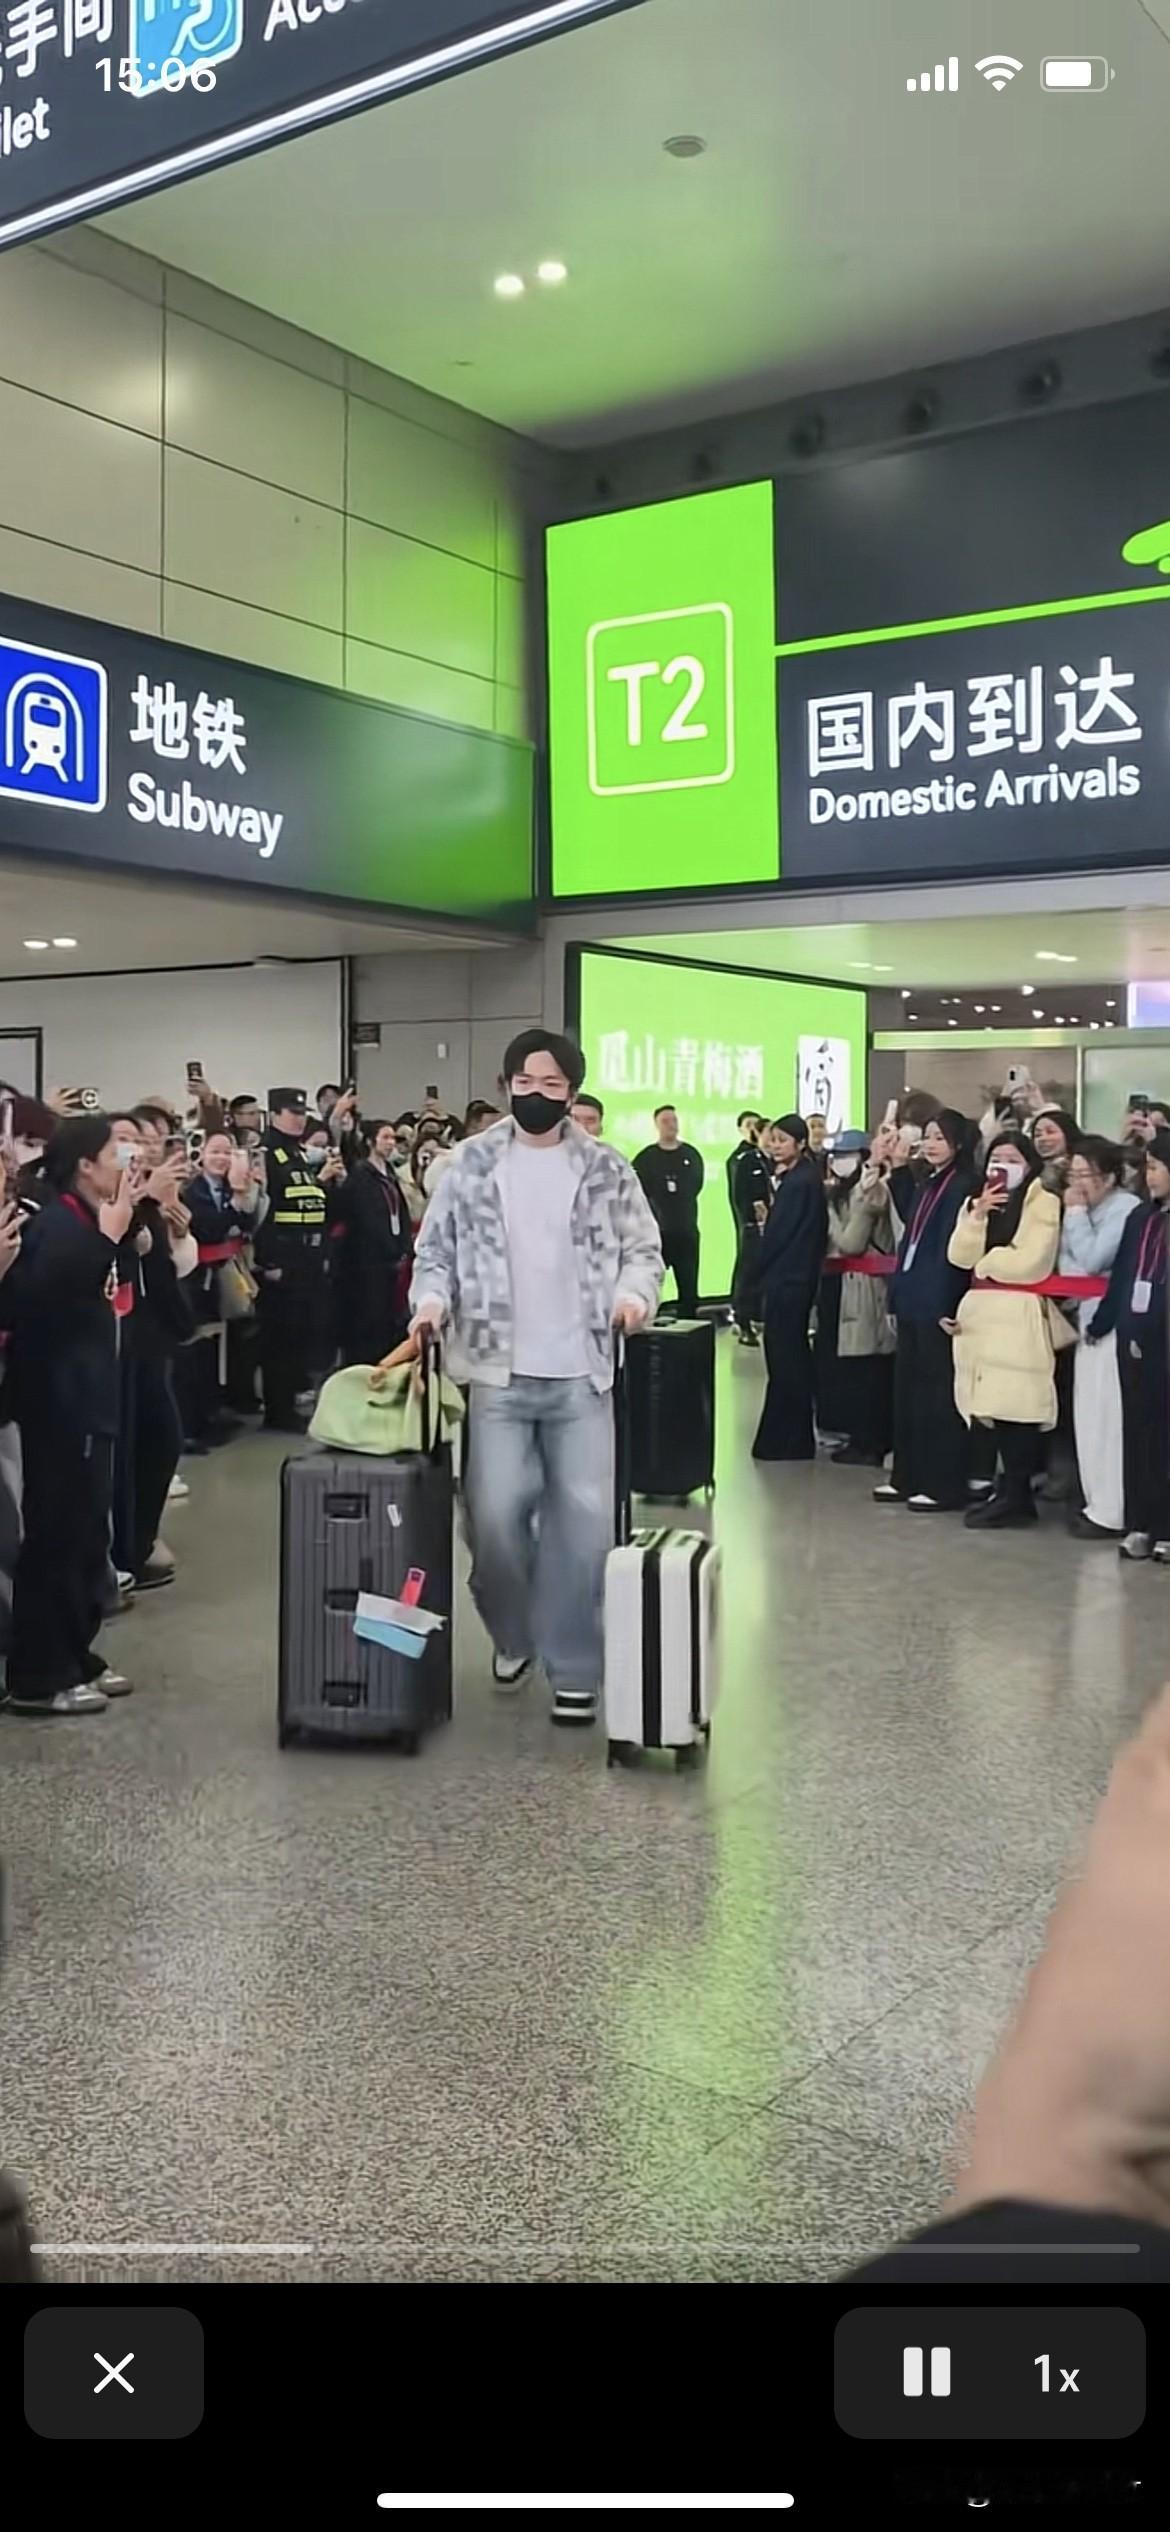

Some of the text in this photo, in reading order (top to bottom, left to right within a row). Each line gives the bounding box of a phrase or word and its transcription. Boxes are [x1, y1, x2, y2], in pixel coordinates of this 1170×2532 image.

[0, 0, 113, 82] 手间
[0, 97, 50, 157] let
[129, 674, 247, 775] 地铁
[606, 654, 709, 747] T2
[807, 656, 1143, 778] 国内到达
[127, 772, 284, 858] Subway
[809, 756, 1141, 825] Domestic Arrivals
